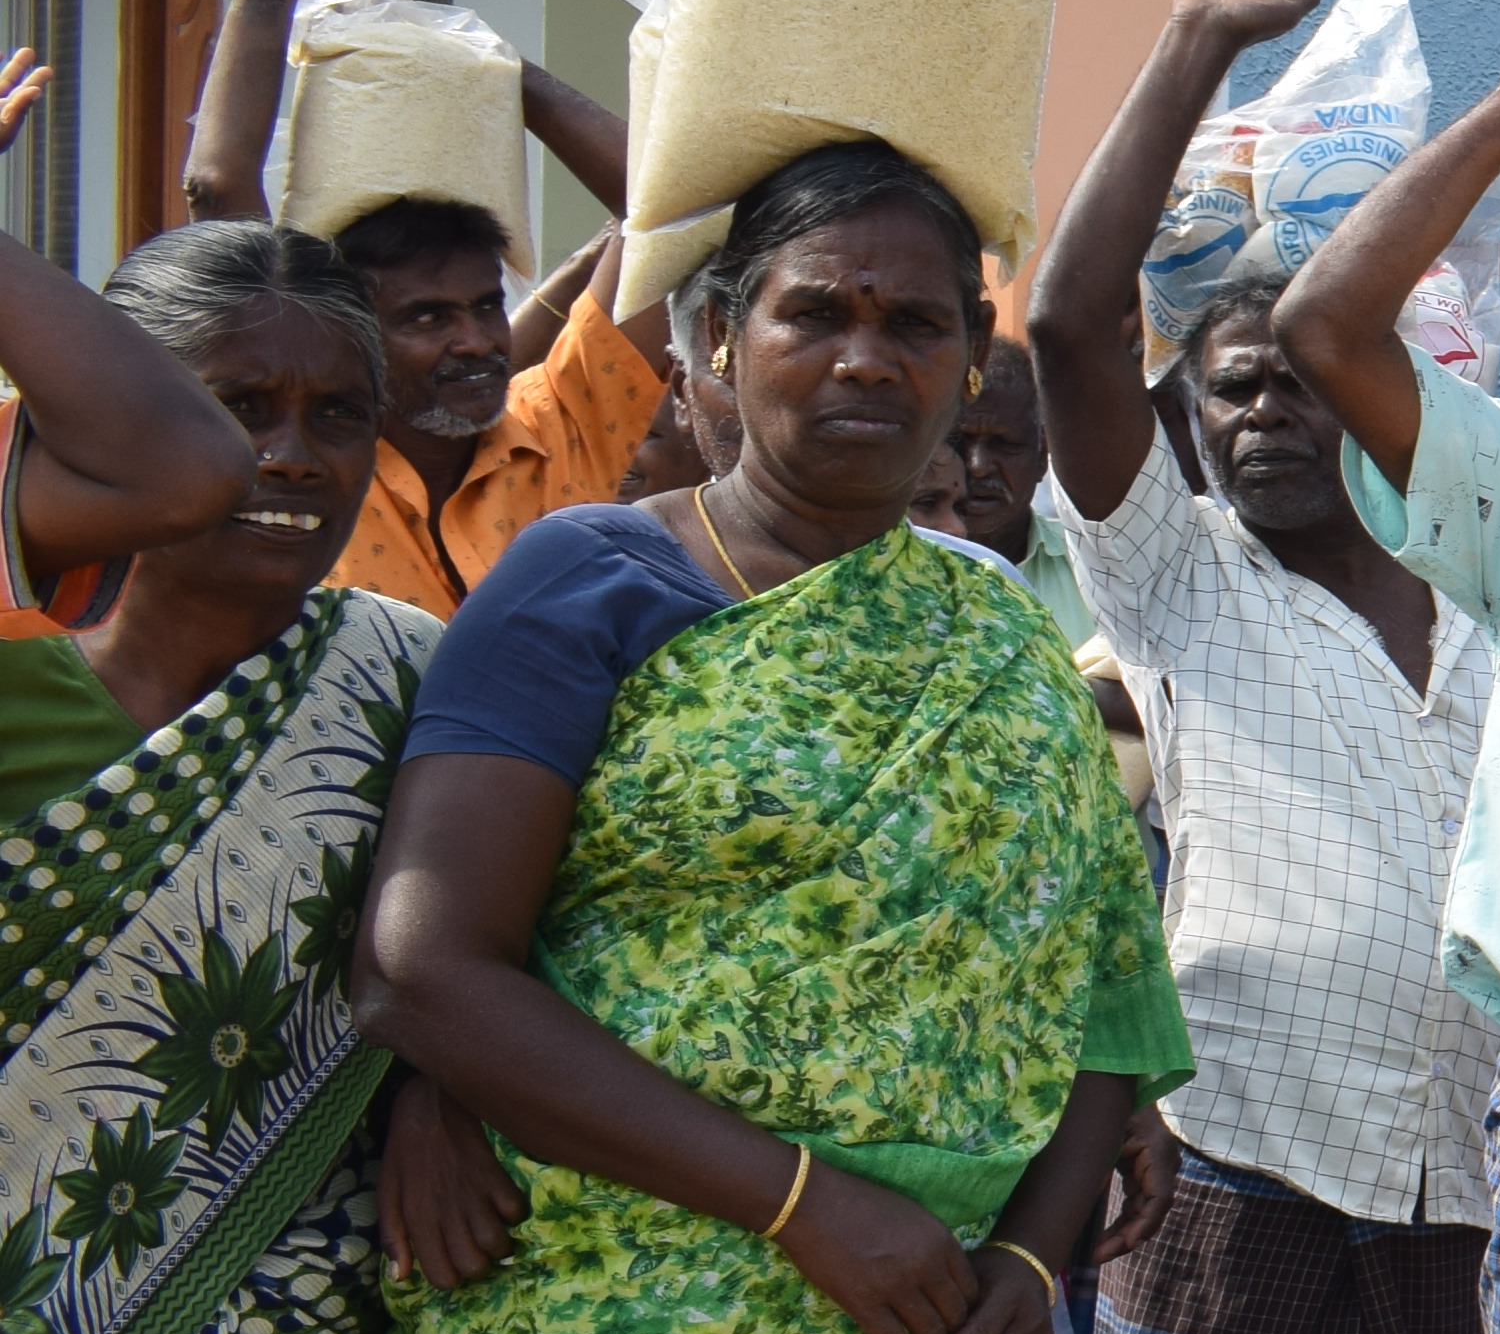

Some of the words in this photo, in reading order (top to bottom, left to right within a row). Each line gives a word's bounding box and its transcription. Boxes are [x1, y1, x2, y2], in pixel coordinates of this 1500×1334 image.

[1315, 102, 1400, 130] INDIA
[1300, 135, 1408, 168] INISTRIES
[1280, 221, 1306, 267] ORD
[1147, 299, 1193, 340] ORD
